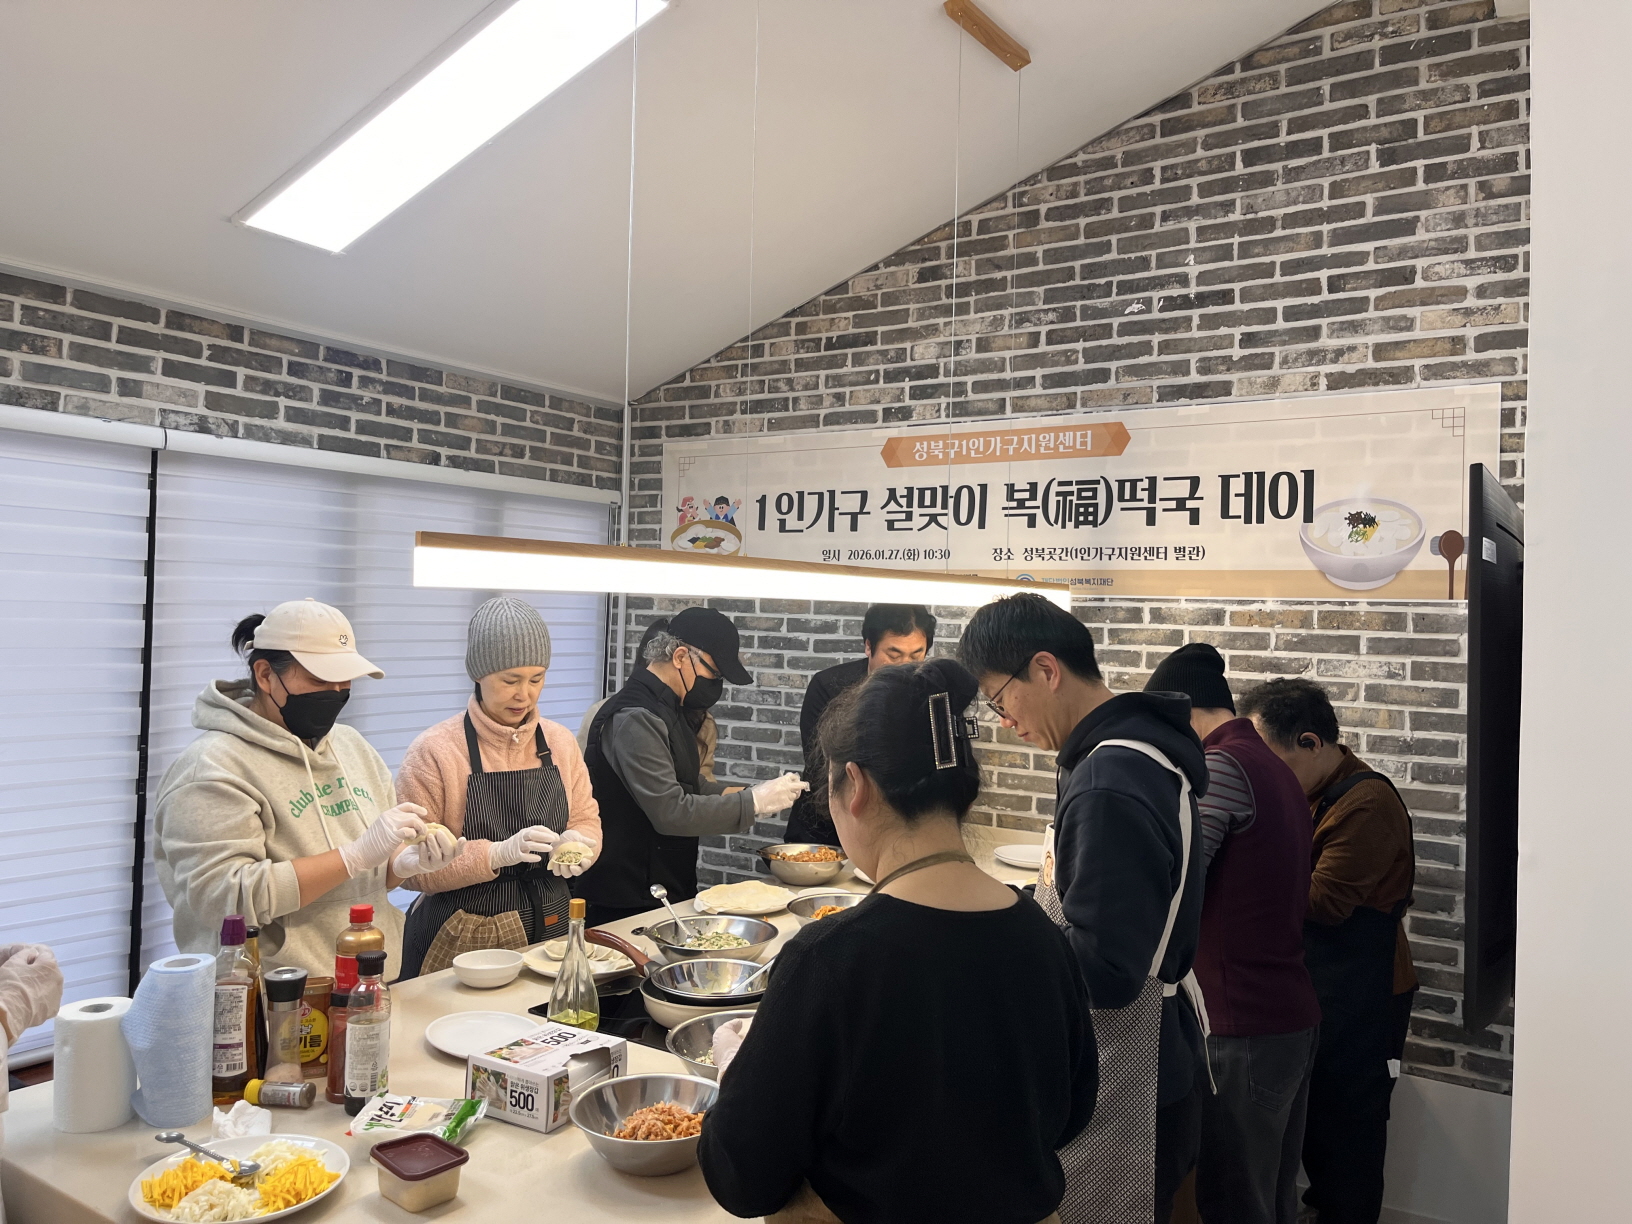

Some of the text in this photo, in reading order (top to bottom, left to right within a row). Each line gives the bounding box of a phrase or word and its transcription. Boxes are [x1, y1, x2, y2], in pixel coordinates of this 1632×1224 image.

[913, 430, 1092, 461] 성북구1인가구지원센터
[755, 469, 1315, 534] 1인가구 설맞이 복(福)떡국 데이
[822, 548, 951, 562] 일시 2026.01.27.(화) 10:30
[992, 545, 1206, 561] 장소 성북곳간(1인가구지원센터 별관)
[289, 789, 315, 818] club
[540, 1031, 577, 1046] 500
[510, 1089, 535, 1112] 500
